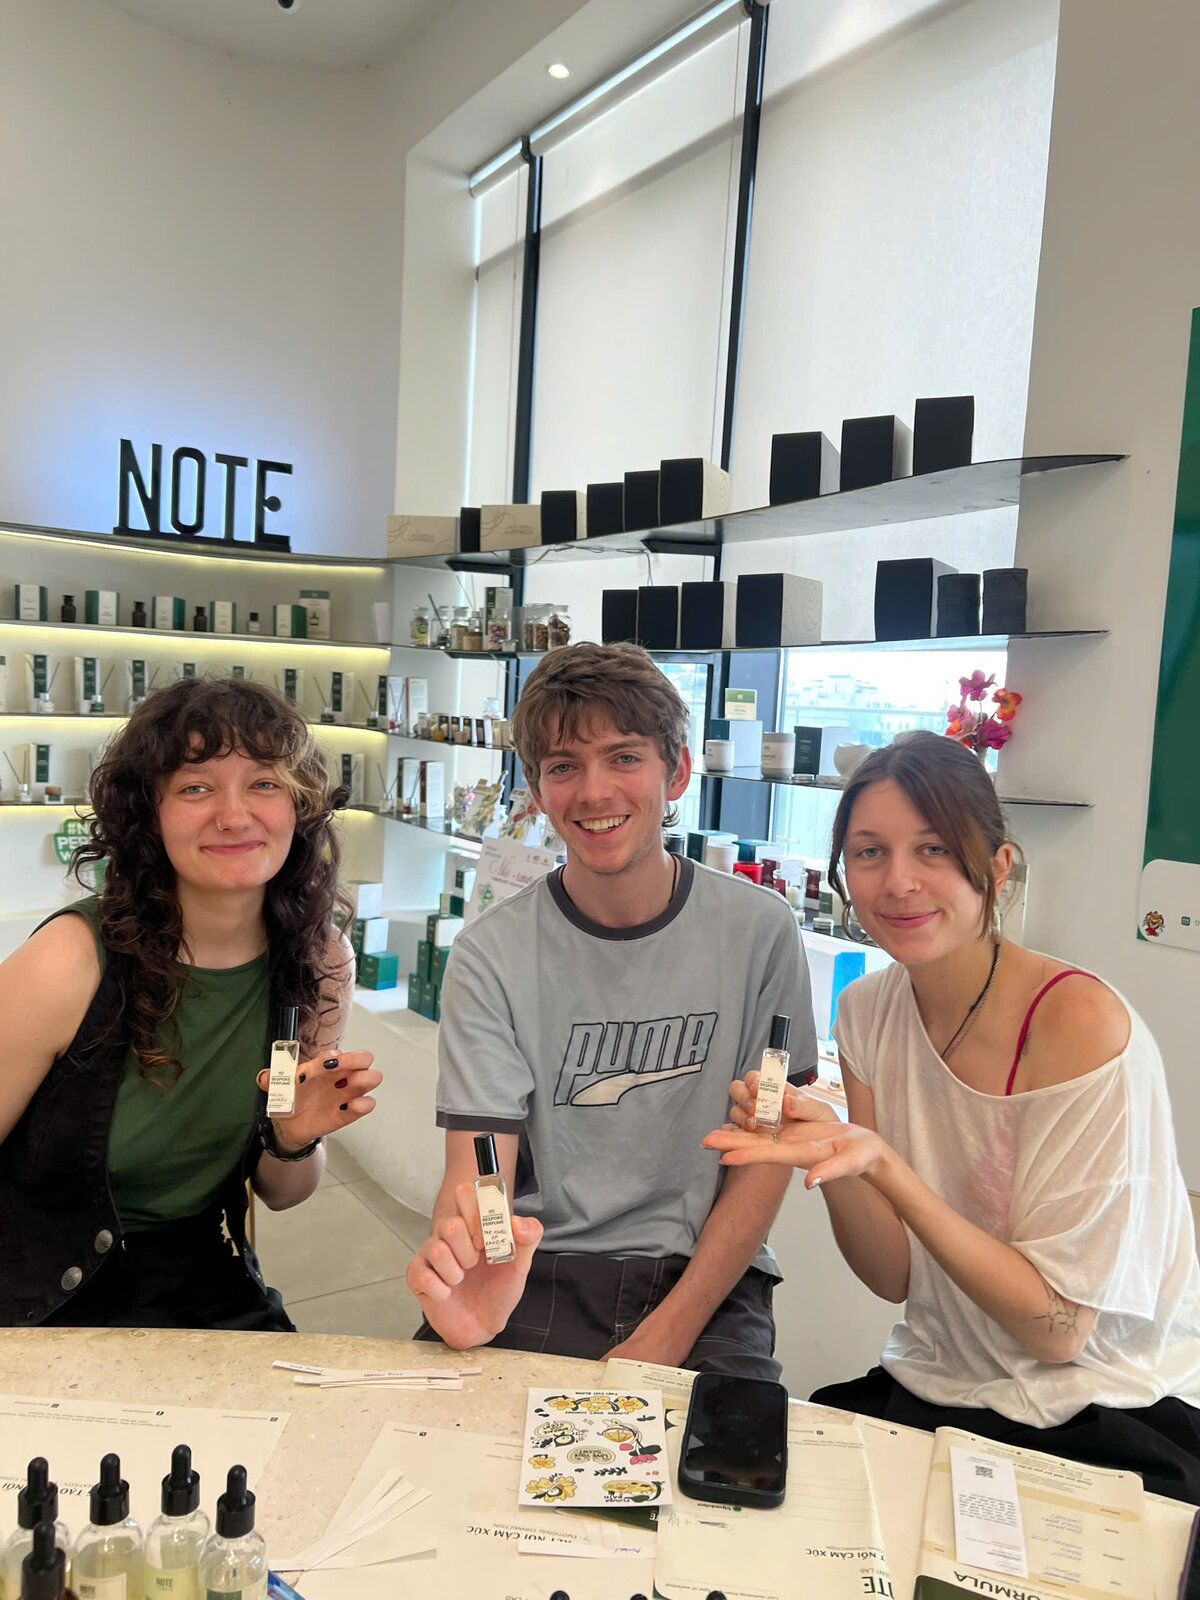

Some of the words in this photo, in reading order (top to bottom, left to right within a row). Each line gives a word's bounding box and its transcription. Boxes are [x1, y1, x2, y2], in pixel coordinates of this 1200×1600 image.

[118, 438, 293, 546] NOTE
[553, 1011, 719, 1107] PUMA
[80, 1585, 96, 1594] NOTE
[156, 1578, 174, 1588] NOTE
